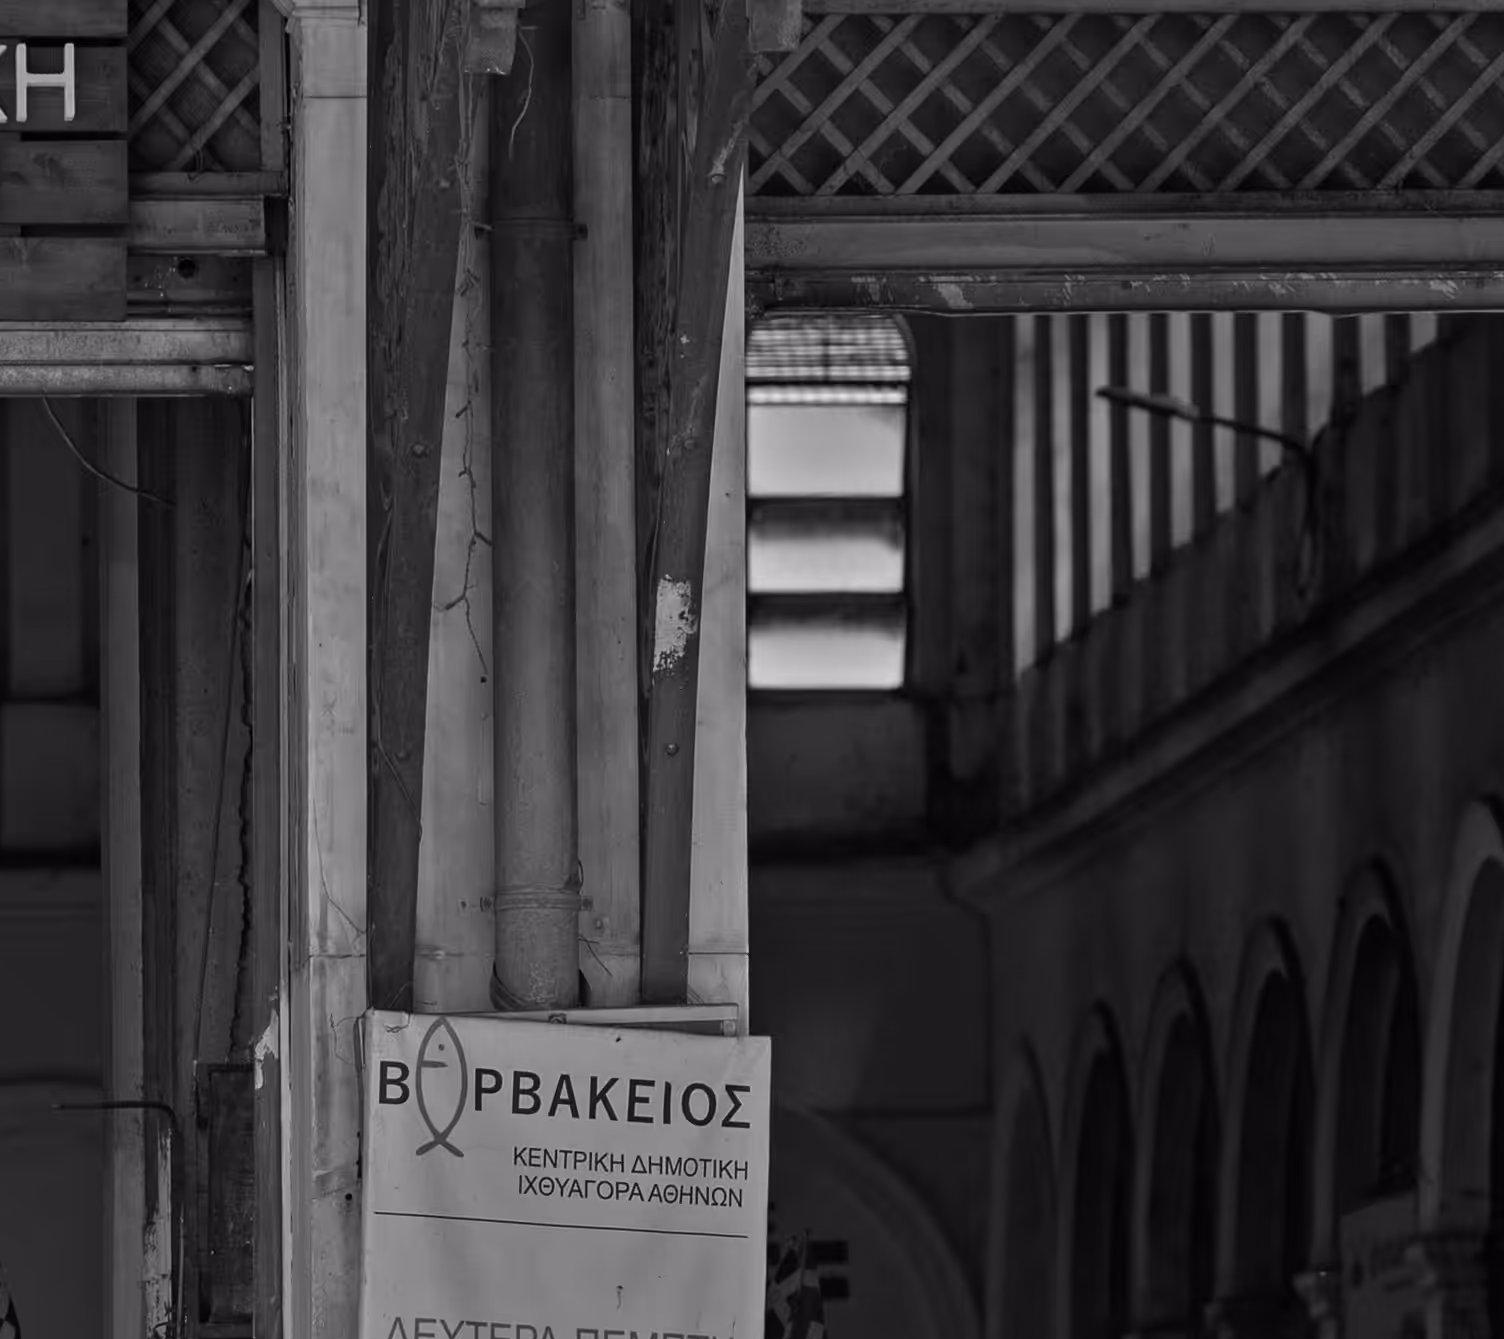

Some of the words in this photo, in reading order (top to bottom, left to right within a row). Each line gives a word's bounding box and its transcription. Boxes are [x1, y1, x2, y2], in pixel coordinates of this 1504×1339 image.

[513, 1147, 625, 1173] ΚΕΝΤΡΙΚΗ
[631, 1153, 748, 1180] ΔΗΜΟΤΙΚΗ
[517, 1175, 646, 1202] ΙΧΘΥΑΓΟΡΑ
[649, 1180, 744, 1207] ΑΘΗΝΩΝ
